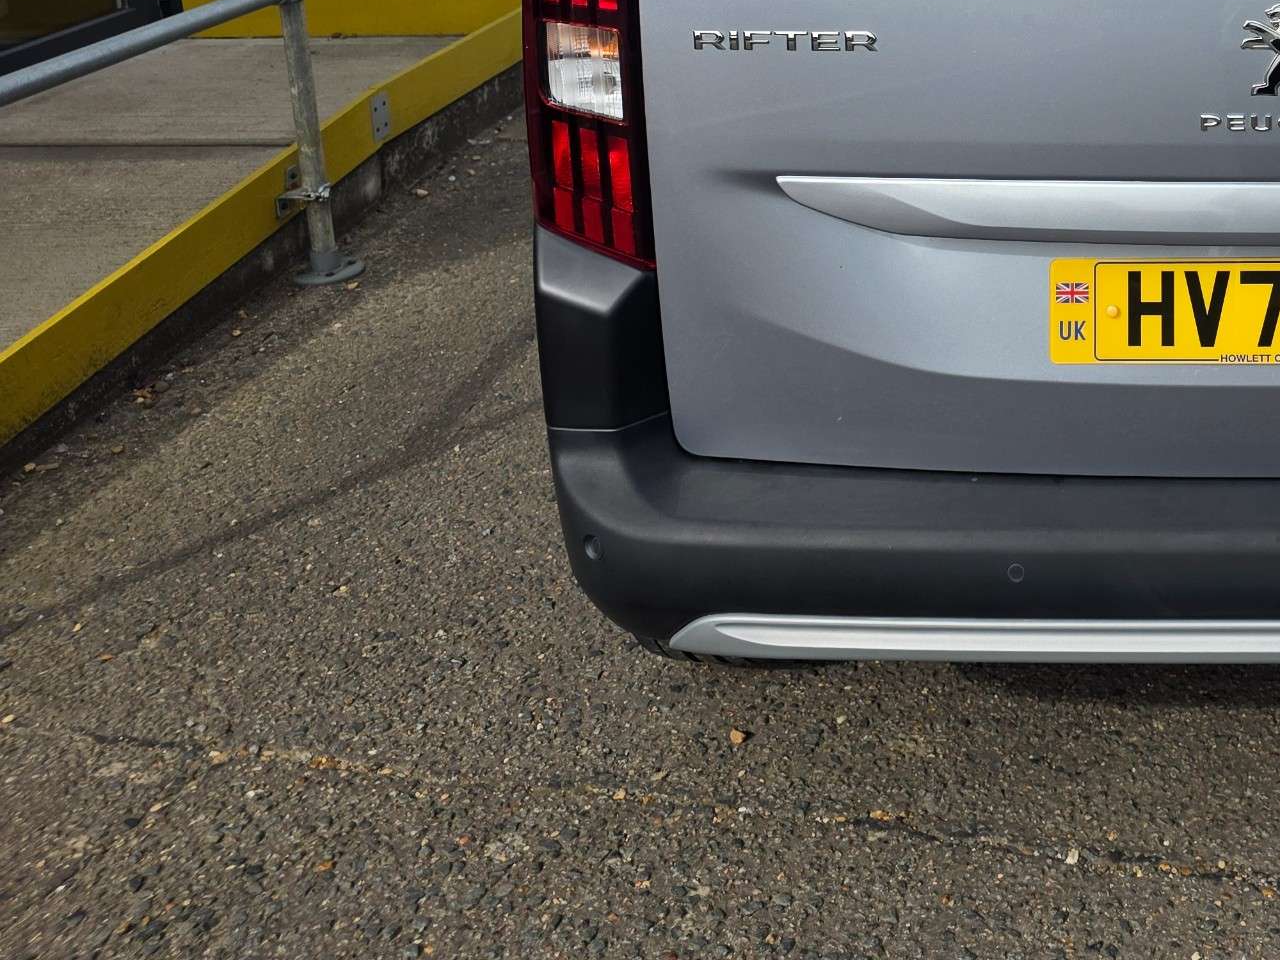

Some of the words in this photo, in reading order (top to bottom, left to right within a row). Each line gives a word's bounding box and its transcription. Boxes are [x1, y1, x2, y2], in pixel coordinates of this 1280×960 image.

[692, 30, 879, 52] RIFTER
[1059, 320, 1086, 341] UK
[1220, 354, 1272, 363] HOWLETT
